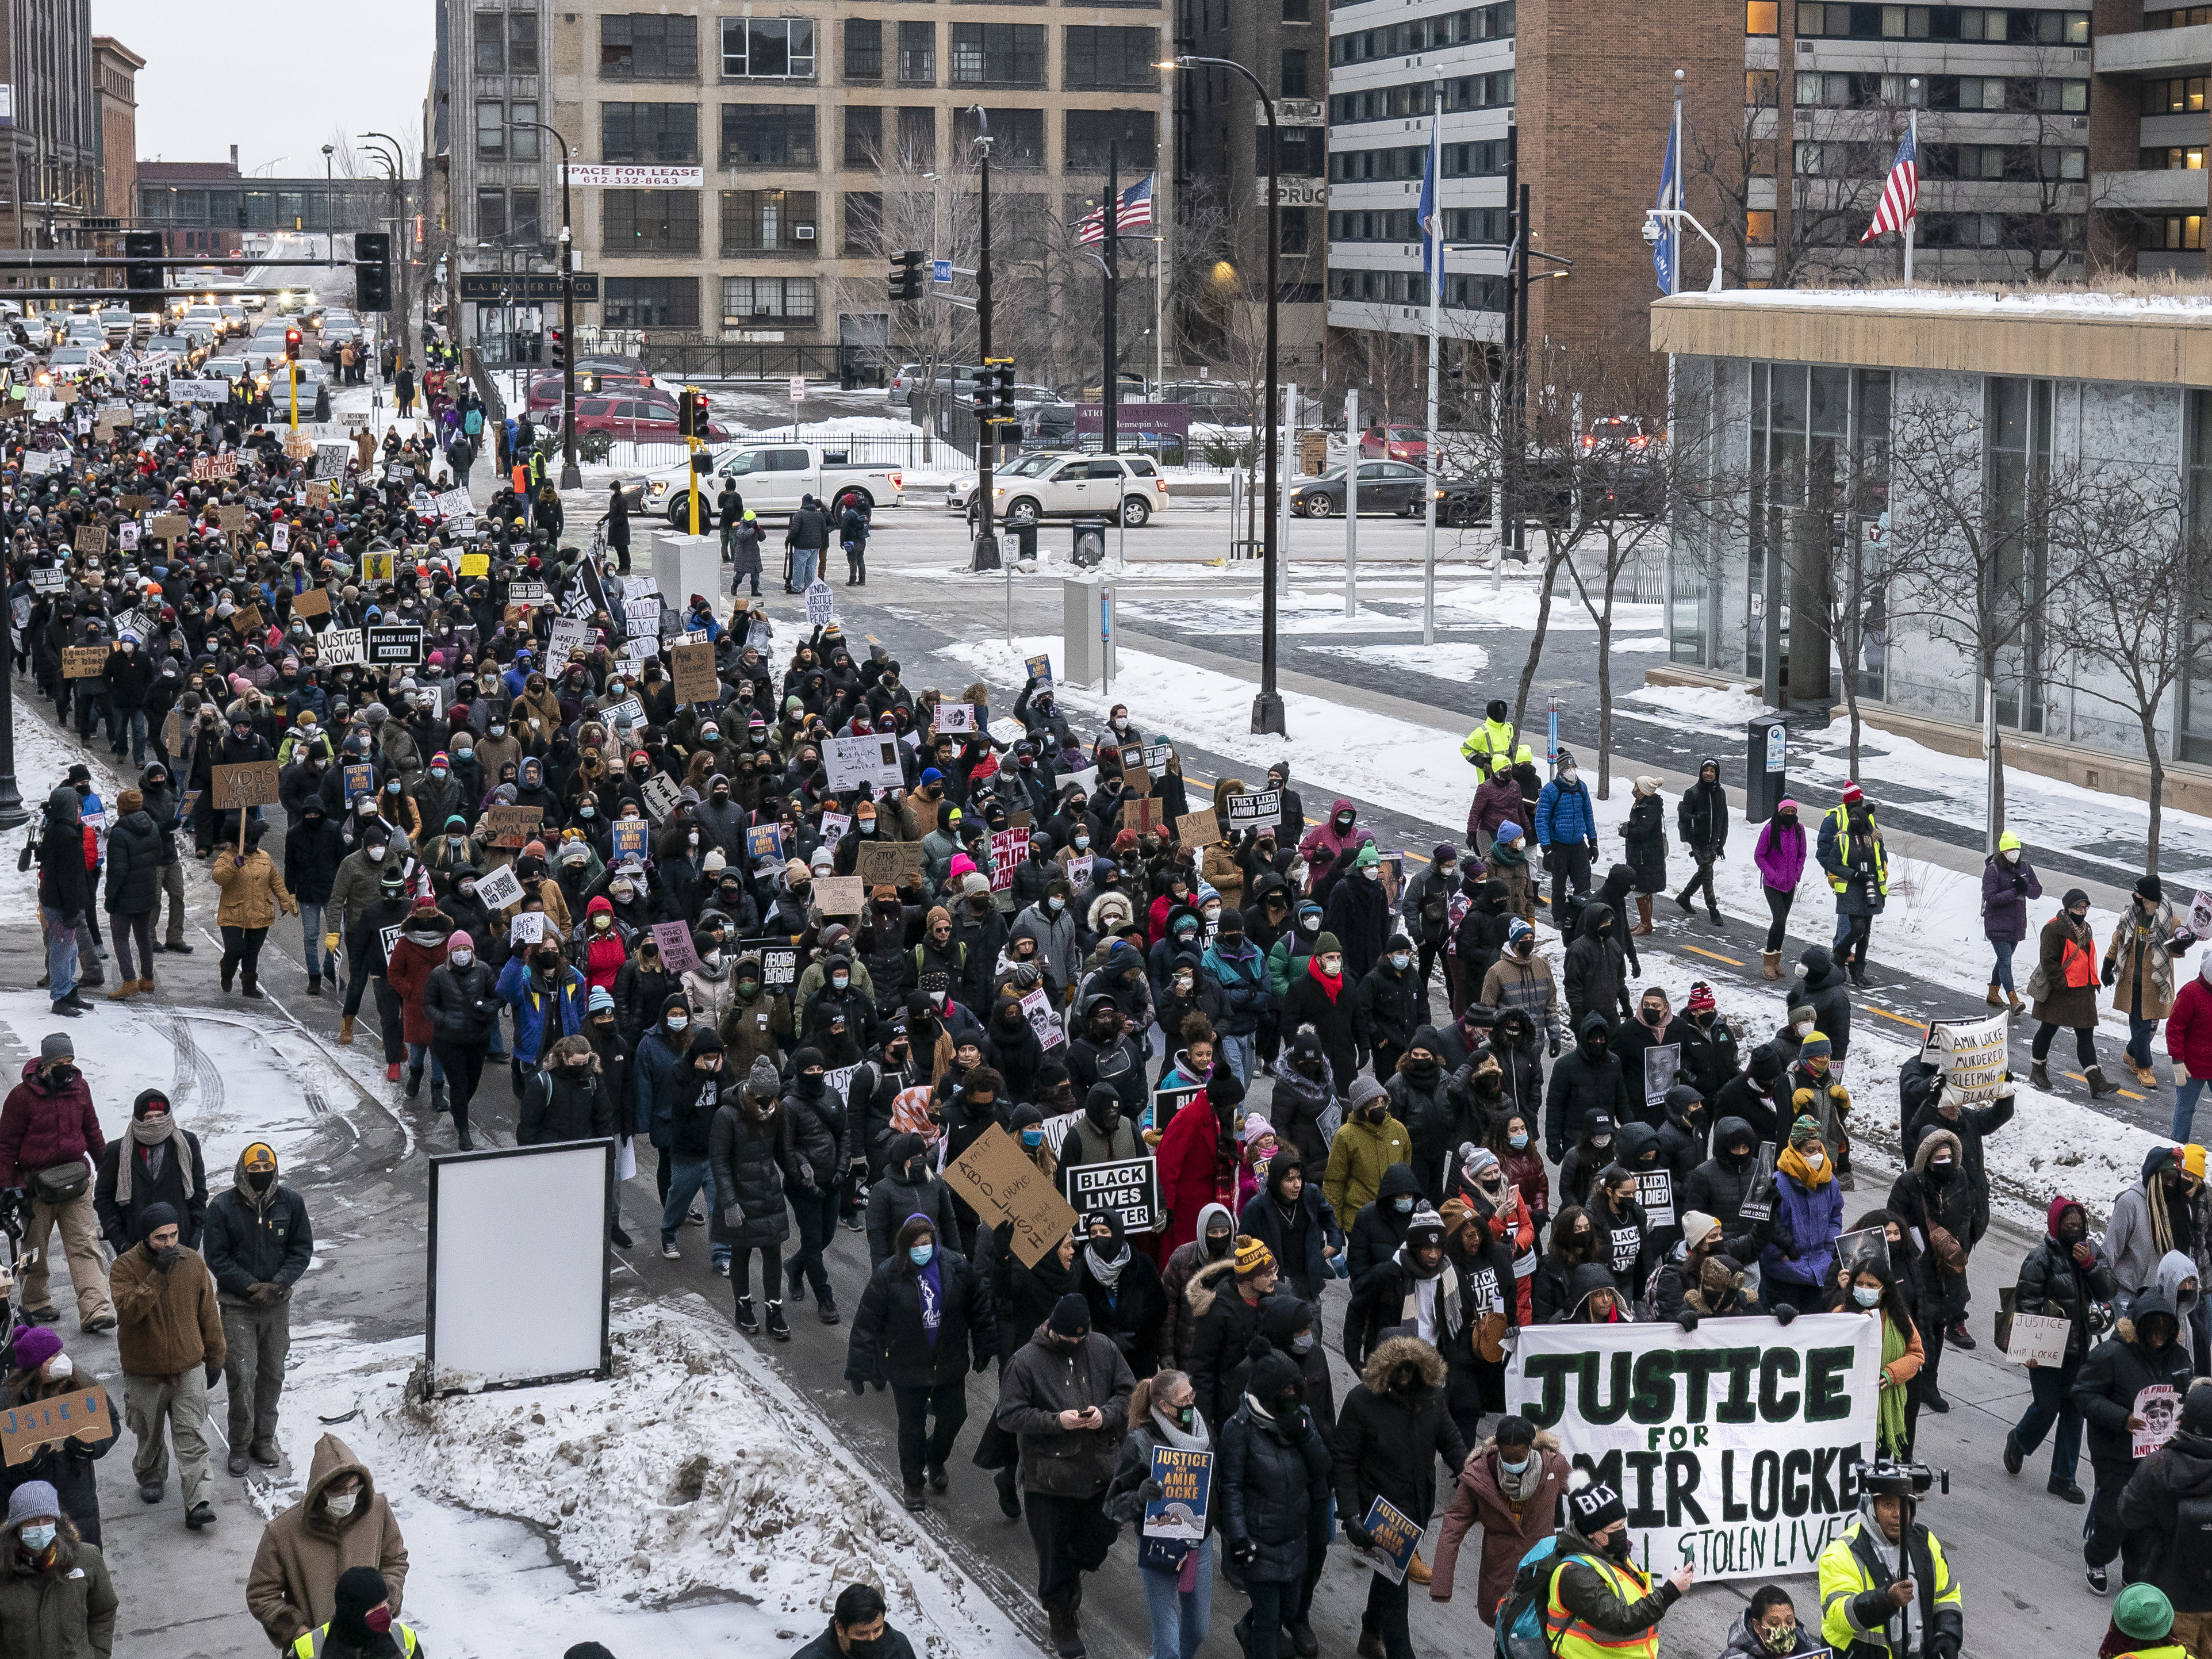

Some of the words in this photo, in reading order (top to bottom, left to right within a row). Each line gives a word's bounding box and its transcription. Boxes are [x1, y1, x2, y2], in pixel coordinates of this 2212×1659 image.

[615, 167, 645, 176] FOR
[651, 168, 700, 177] LEASE
[582, 176, 679, 186] 612-332-8643
[467, 283, 488, 292] L.A.
[492, 283, 545, 292] ROCKER
[576, 282, 592, 292] CO.
[1082, 409, 1103, 418] ATRI
[325, 447, 339, 455] NO
[193, 457, 209, 468] END
[316, 455, 344, 465] MORE
[437, 486, 469, 504] JUSTICE
[448, 504, 469, 515] OCKE
[626, 578, 655, 597] STOP
[807, 594, 833, 606] JUSTICE
[626, 601, 660, 618] KILLING
[809, 613, 832, 624] PEACE
[627, 619, 658, 634] BLACK
[319, 631, 362, 650] JUSTICE
[372, 635, 396, 643] BLACK
[398, 634, 419, 643] LIVES
[63, 648, 107, 658] teachers
[381, 647, 409, 656] MATTER
[630, 637, 655, 658] MEN
[63, 657, 76, 665] for
[324, 647, 355, 664] NOW
[1027, 654, 1048, 665] JUSTICE
[346, 765, 370, 774] JUSTICE
[649, 775, 672, 802] Amir
[1231, 796, 1253, 806] FREY
[1256, 794, 1277, 804] LIED,
[1232, 806, 1256, 817] AMIR
[1258, 802, 1278, 814] DIED
[824, 811, 831, 819] TO
[831, 814, 850, 823] PROTECT
[1178, 814, 1202, 830] BAN
[616, 821, 645, 830] JUSTICE
[749, 826, 776, 837] JUSTICE
[500, 835, 526, 846] CHI
[621, 833, 640, 842] AMIR
[755, 837, 773, 847] AMIR
[991, 828, 1029, 849] JUSTICE
[619, 841, 642, 850] LOCKE
[753, 844, 776, 855] LOCKE
[876, 851, 896, 860] STOP
[1075, 856, 1092, 864] PROTECT
[481, 883, 493, 898] NO
[490, 873, 512, 890] JUSTICE
[815, 878, 861, 890] JUSTICE
[487, 892, 500, 906] NO
[498, 882, 517, 899] PEACE
[827, 897, 856, 905] AMIR
[822, 904, 860, 913] LOCKE
[663, 936, 684, 945] COMMIT
[664, 947, 691, 957] MURDERS
[668, 957, 692, 968] REPORTS
[765, 951, 796, 967] ABOLISH
[1022, 990, 1044, 1006] PROTECT
[1044, 1035, 1064, 1048] SERVE?
[1953, 1032, 1977, 1050] AMIR
[1979, 1027, 2004, 1048] LOCKE
[1955, 1048, 2004, 1070] MURDERED
[1952, 1067, 1996, 1087] SLEEPING
[1080, 1166, 1145, 1190] BLACK
[1643, 1175, 1667, 1189] LIED,
[1086, 1188, 1142, 1209] LIVES
[1644, 1189, 1669, 1205] DIED
[2015, 1314, 2064, 1330] JUSTICE
[2004, 1348, 2027, 1358] AMIR
[2031, 1350, 2058, 1360] LOCKE
[1520, 1344, 1856, 1426] JUSTICE
[2140, 1386, 2149, 1396] TO
[1646, 1424, 1710, 1451] FOR
[2134, 1443, 2153, 1455] AND
[1156, 1451, 1209, 1468] JUSTICE
[1163, 1472, 1197, 1487] AMIR
[1554, 1448, 1712, 1530] MIR
[1720, 1441, 1863, 1524] LOCKE
[1164, 1484, 1199, 1500] OCKE
[1376, 1501, 1417, 1541] JUSTICE
[1375, 1523, 1405, 1546] AMIR
[1676, 1523, 1771, 1578] STOLEN
